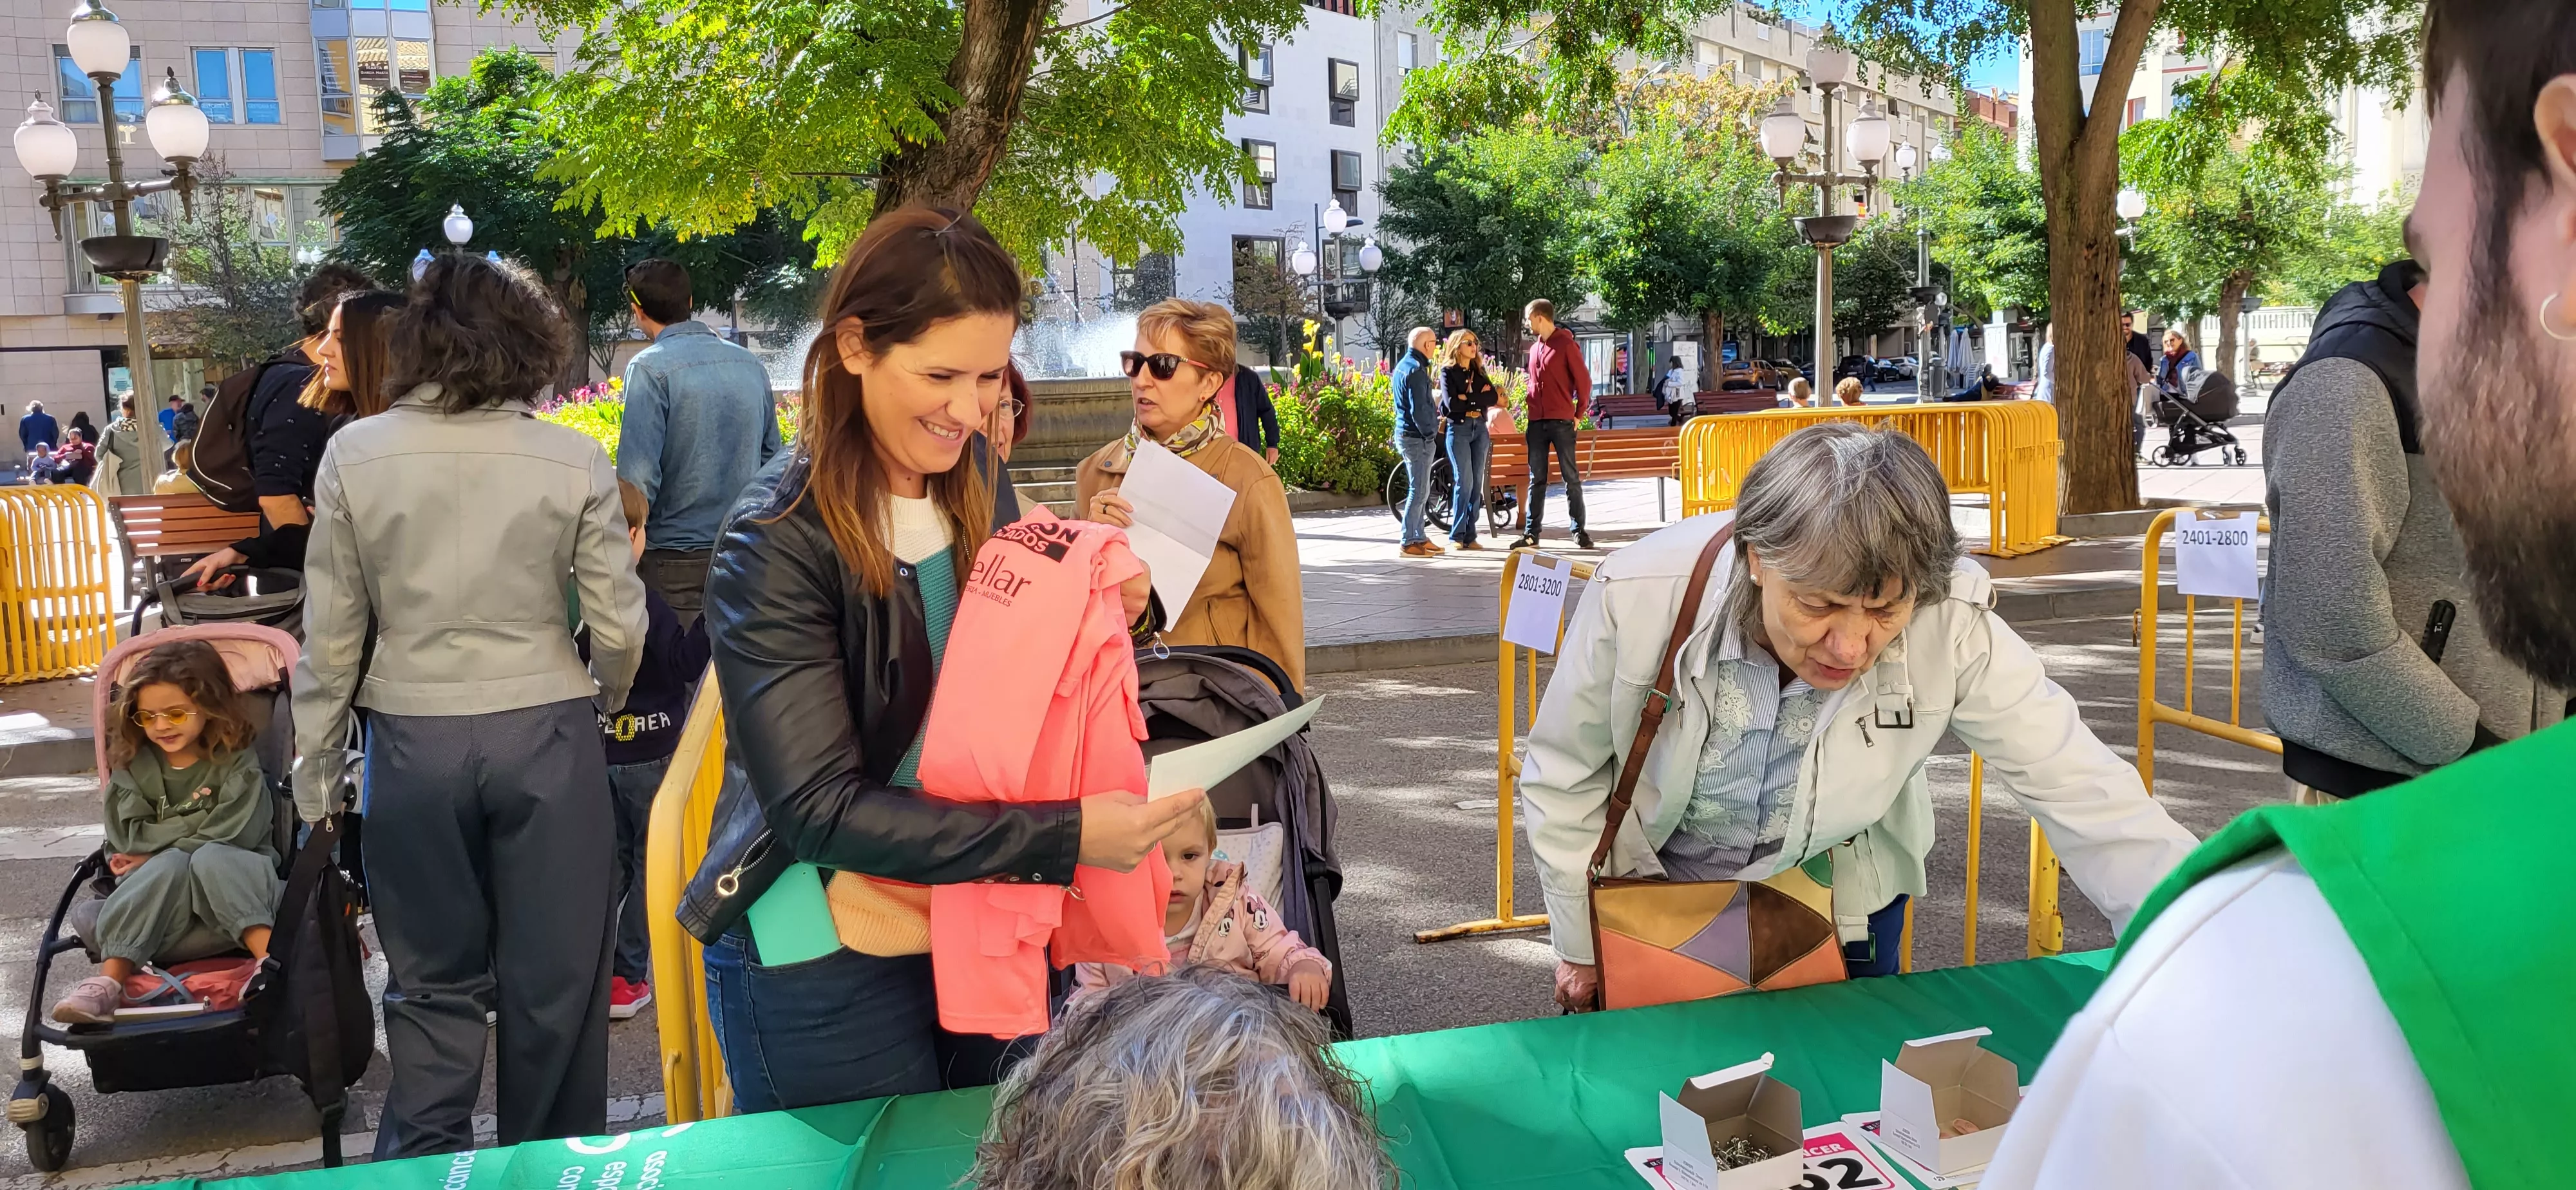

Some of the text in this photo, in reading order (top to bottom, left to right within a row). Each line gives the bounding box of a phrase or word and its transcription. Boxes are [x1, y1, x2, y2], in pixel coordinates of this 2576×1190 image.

[2182, 530, 2248, 546] 2401-2800
[969, 554, 1032, 598] ellar
[1518, 573, 1562, 597] 2801-3200
